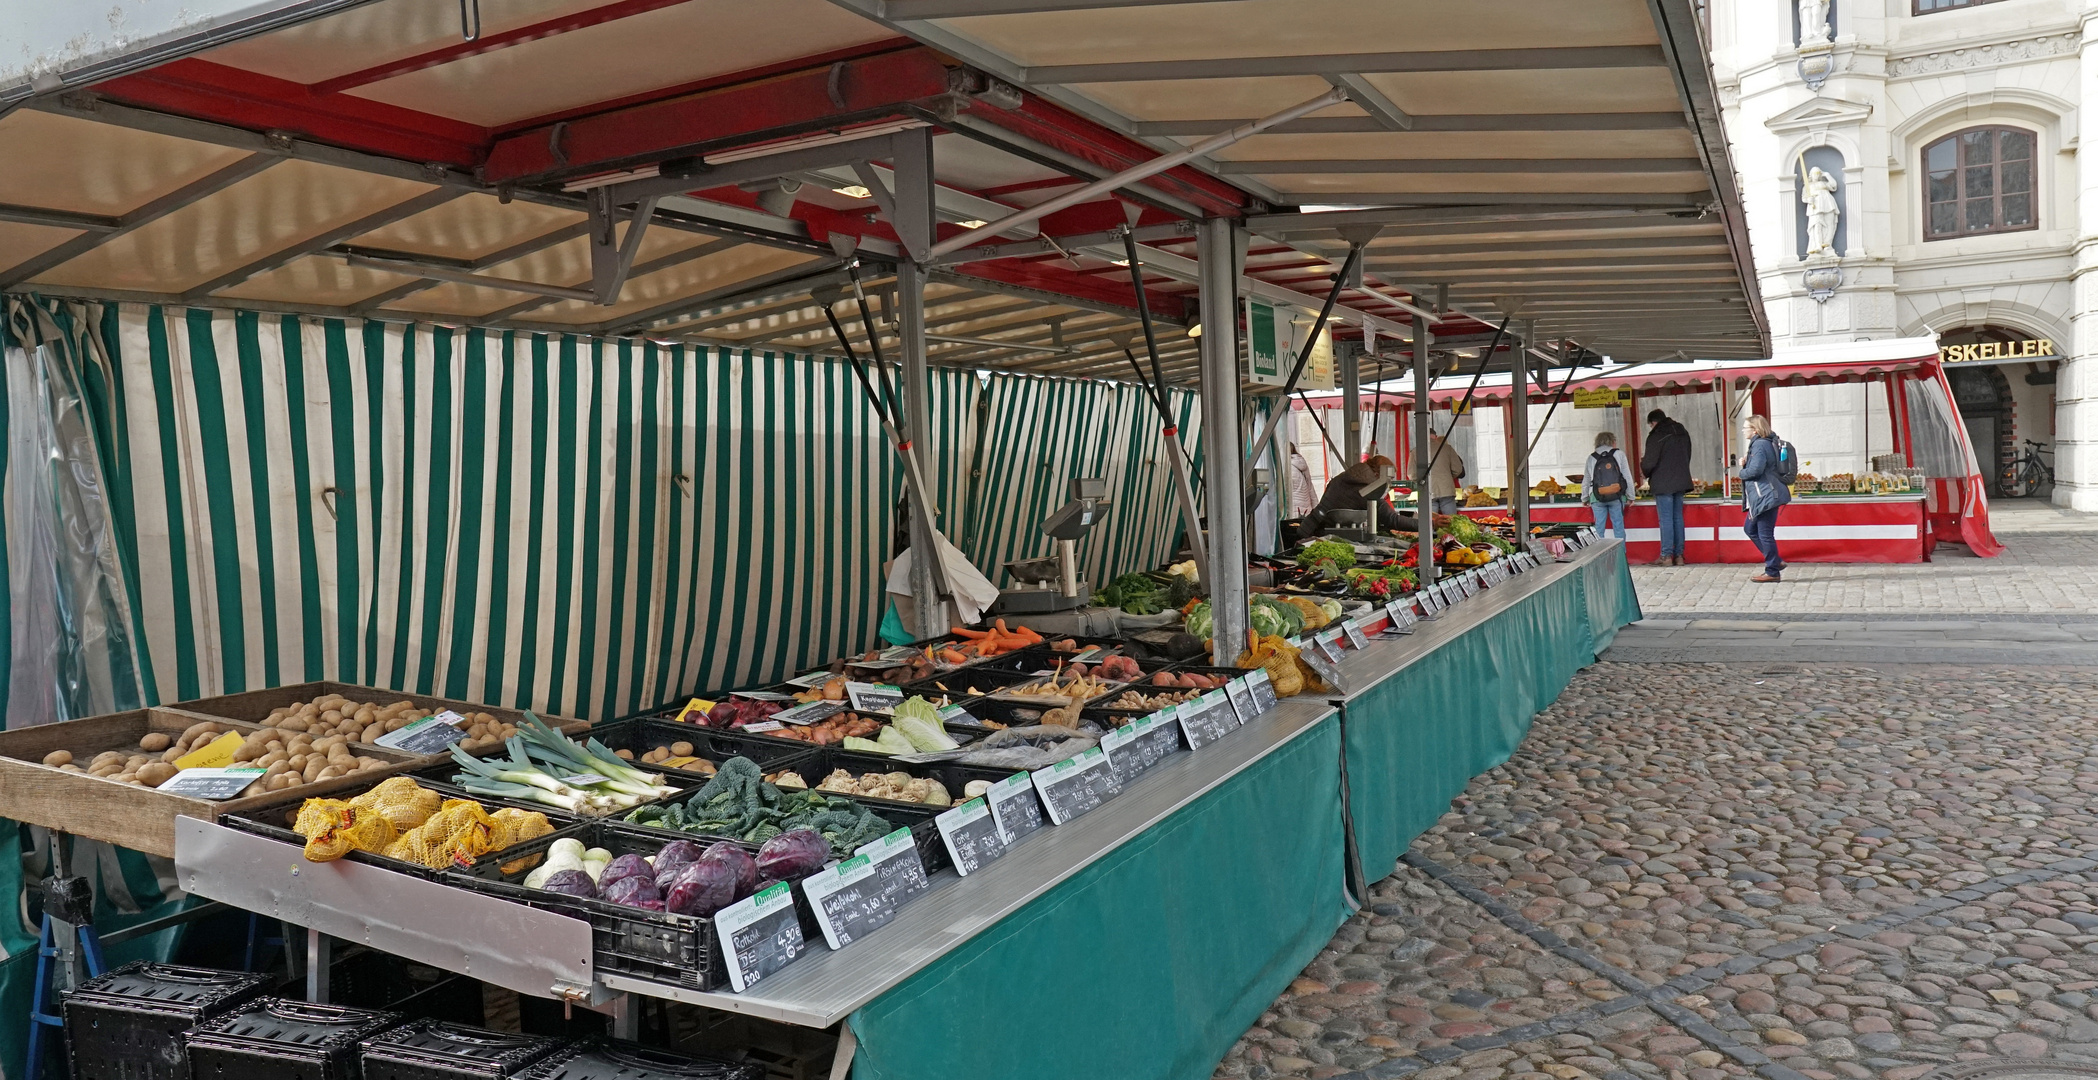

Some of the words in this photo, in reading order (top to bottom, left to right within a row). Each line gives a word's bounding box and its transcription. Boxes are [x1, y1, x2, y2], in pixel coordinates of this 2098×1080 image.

[1255, 350, 1275, 370] Bioland
[1940, 339, 2054, 363] TSKELLER
[839, 858, 866, 876] Qualität
[918, 864, 925, 874] €
[756, 885, 786, 906] Qualität
[771, 896, 787, 908] Anbau
[862, 897, 880, 915] 3,60
[881, 893, 887, 902] €
[733, 928, 761, 949] Rotkohl
[740, 949, 757, 968] DE
[777, 927, 796, 948] 4,90
[795, 926, 801, 937] €
[744, 970, 760, 987] 320
